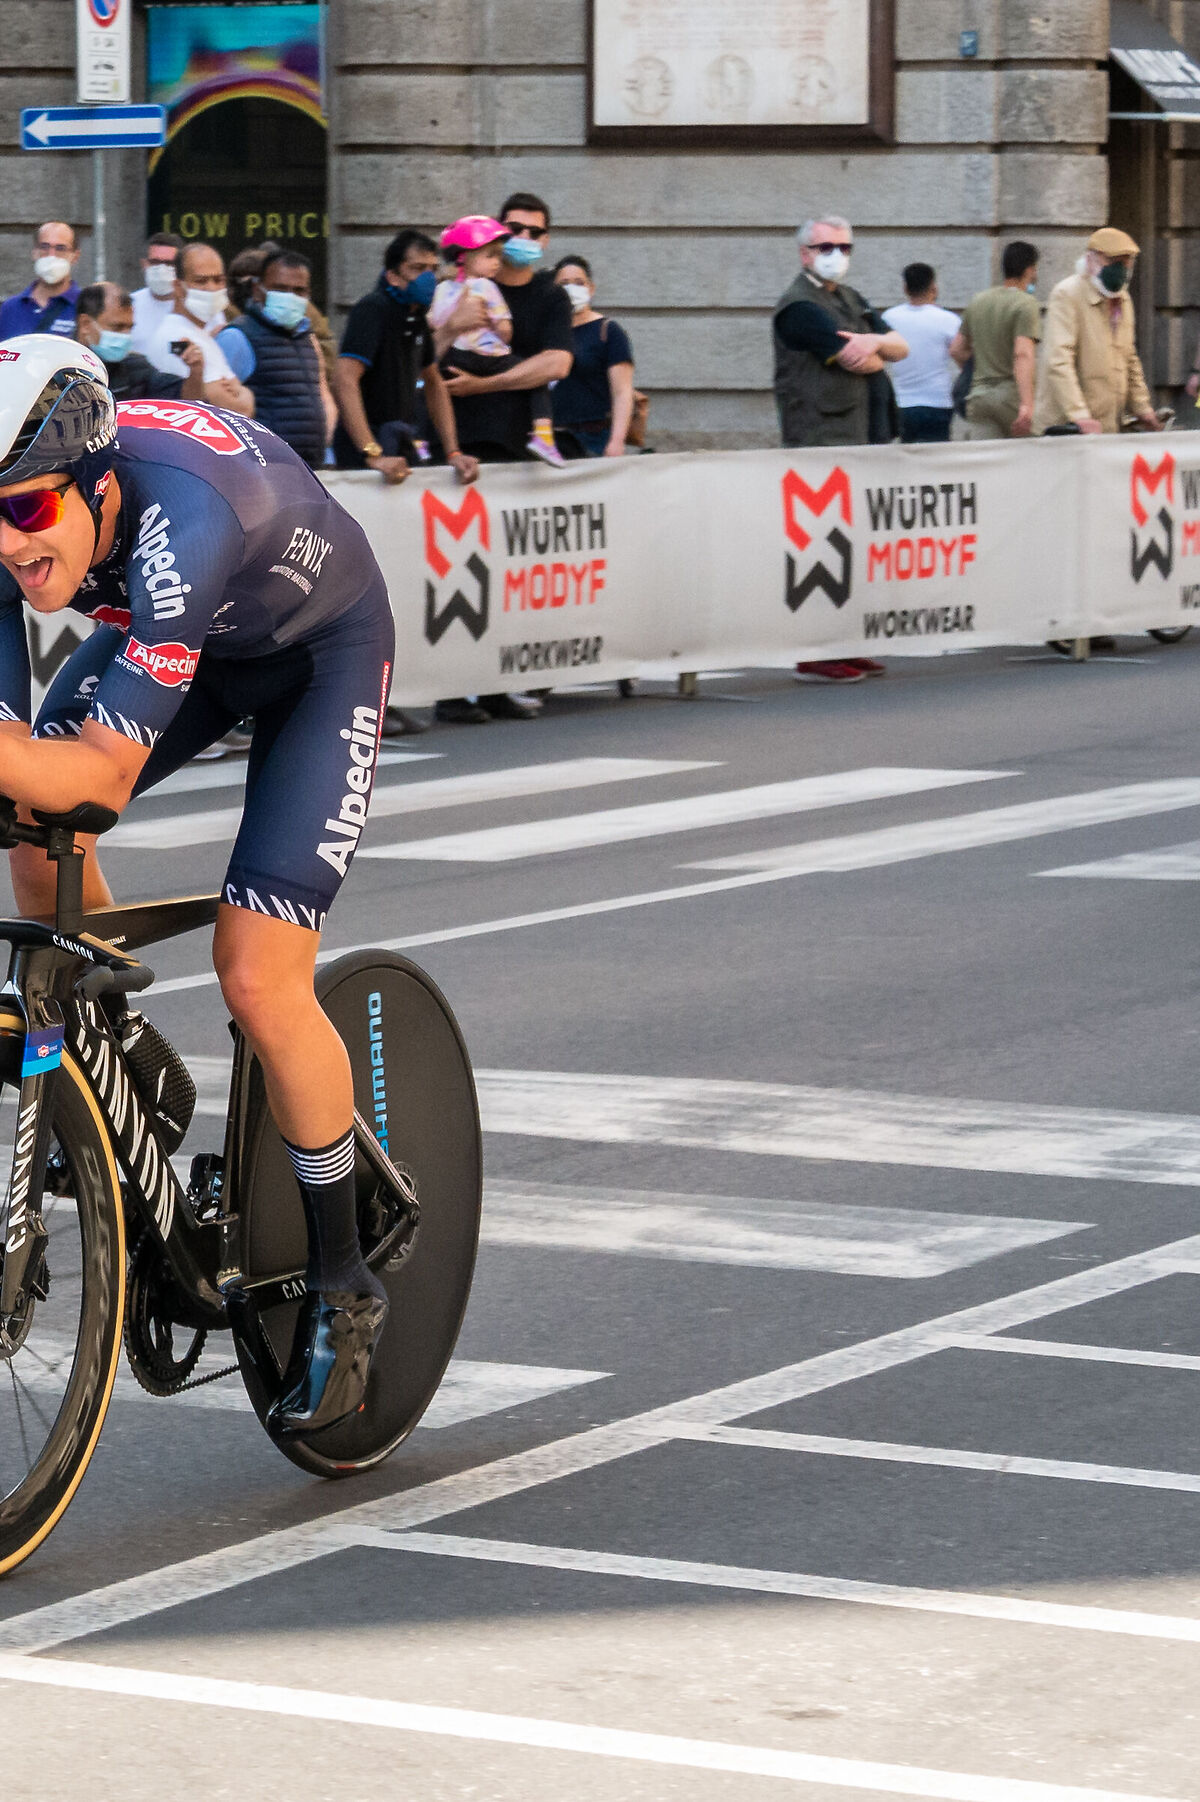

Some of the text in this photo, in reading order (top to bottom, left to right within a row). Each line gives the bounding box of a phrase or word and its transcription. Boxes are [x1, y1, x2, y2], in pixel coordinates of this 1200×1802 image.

[162, 212, 230, 238] LOW
[133, 503, 192, 621] Alpecin
[281, 527, 329, 578] FENIX
[867, 534, 978, 583] MODYF
[503, 559, 607, 613] MODYF
[863, 605, 976, 639] WORKWEAR
[114, 654, 145, 677] CAFFEINE
[132, 645, 196, 675] Alpecin
[316, 705, 378, 878] Alpecin
[52, 933, 95, 962] CANYON
[5, 1100, 38, 1253] CANYON
